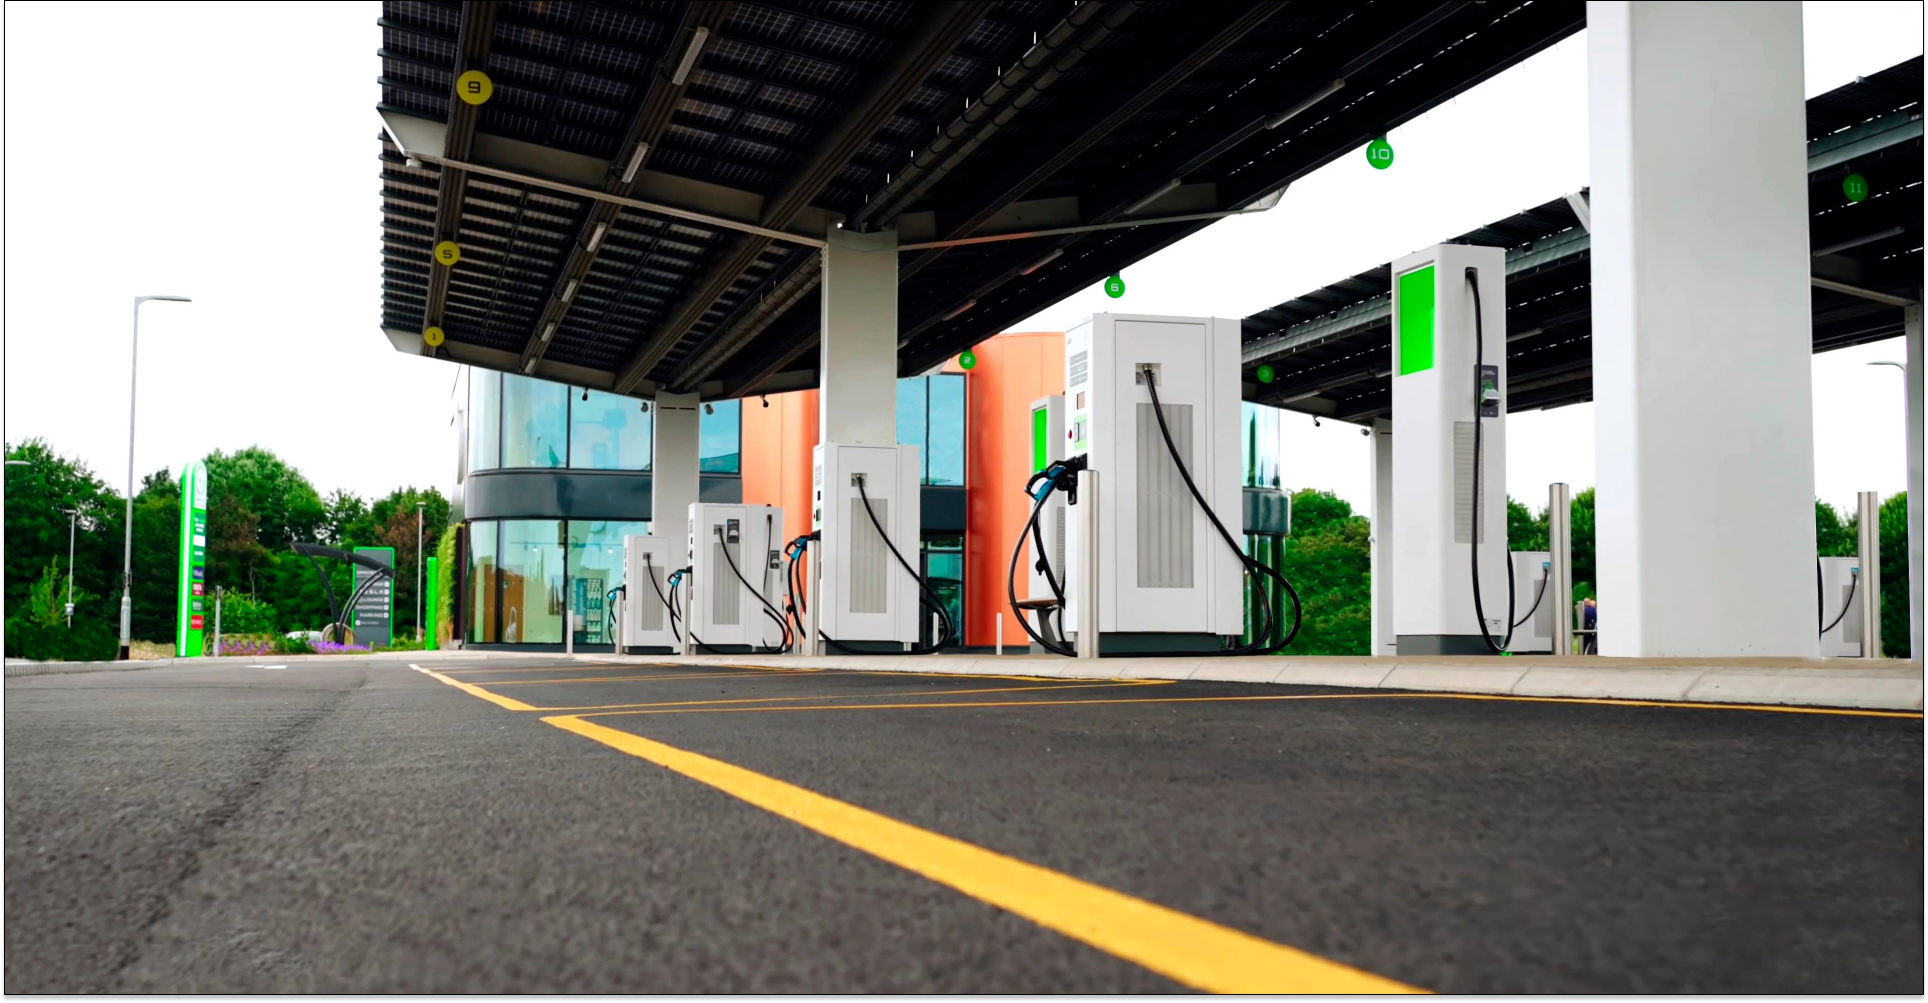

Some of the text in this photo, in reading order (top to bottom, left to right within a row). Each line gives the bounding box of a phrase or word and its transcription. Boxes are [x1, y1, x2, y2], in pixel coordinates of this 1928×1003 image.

[468, 81, 480, 93] 9
[1371, 148, 1390, 160] 10
[1850, 182, 1862, 194] 11
[442, 249, 453, 259] 5
[1110, 283, 1119, 292] 6
[432, 333, 436, 341] 1
[964, 356, 971, 364] 2
